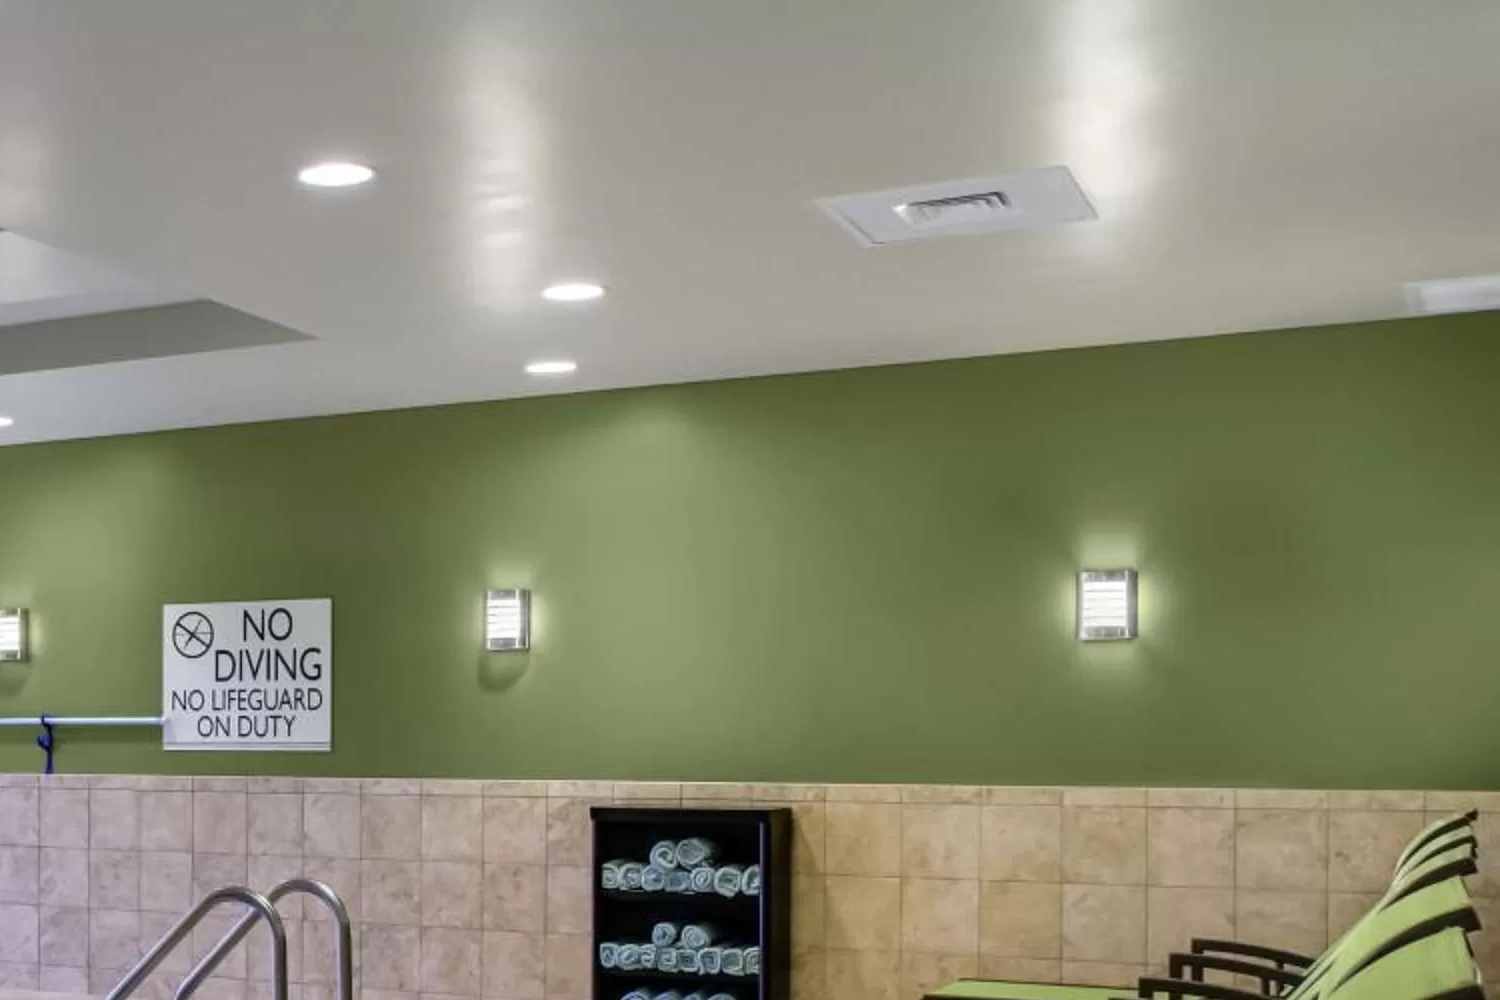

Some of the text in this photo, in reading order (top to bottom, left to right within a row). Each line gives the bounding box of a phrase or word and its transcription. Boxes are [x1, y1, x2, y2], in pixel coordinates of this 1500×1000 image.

[243, 607, 293, 642] NO
[215, 647, 323, 682] DIVING
[171, 687, 323, 711] NO LIFEGUARD
[197, 715, 296, 738] ON DUTY
